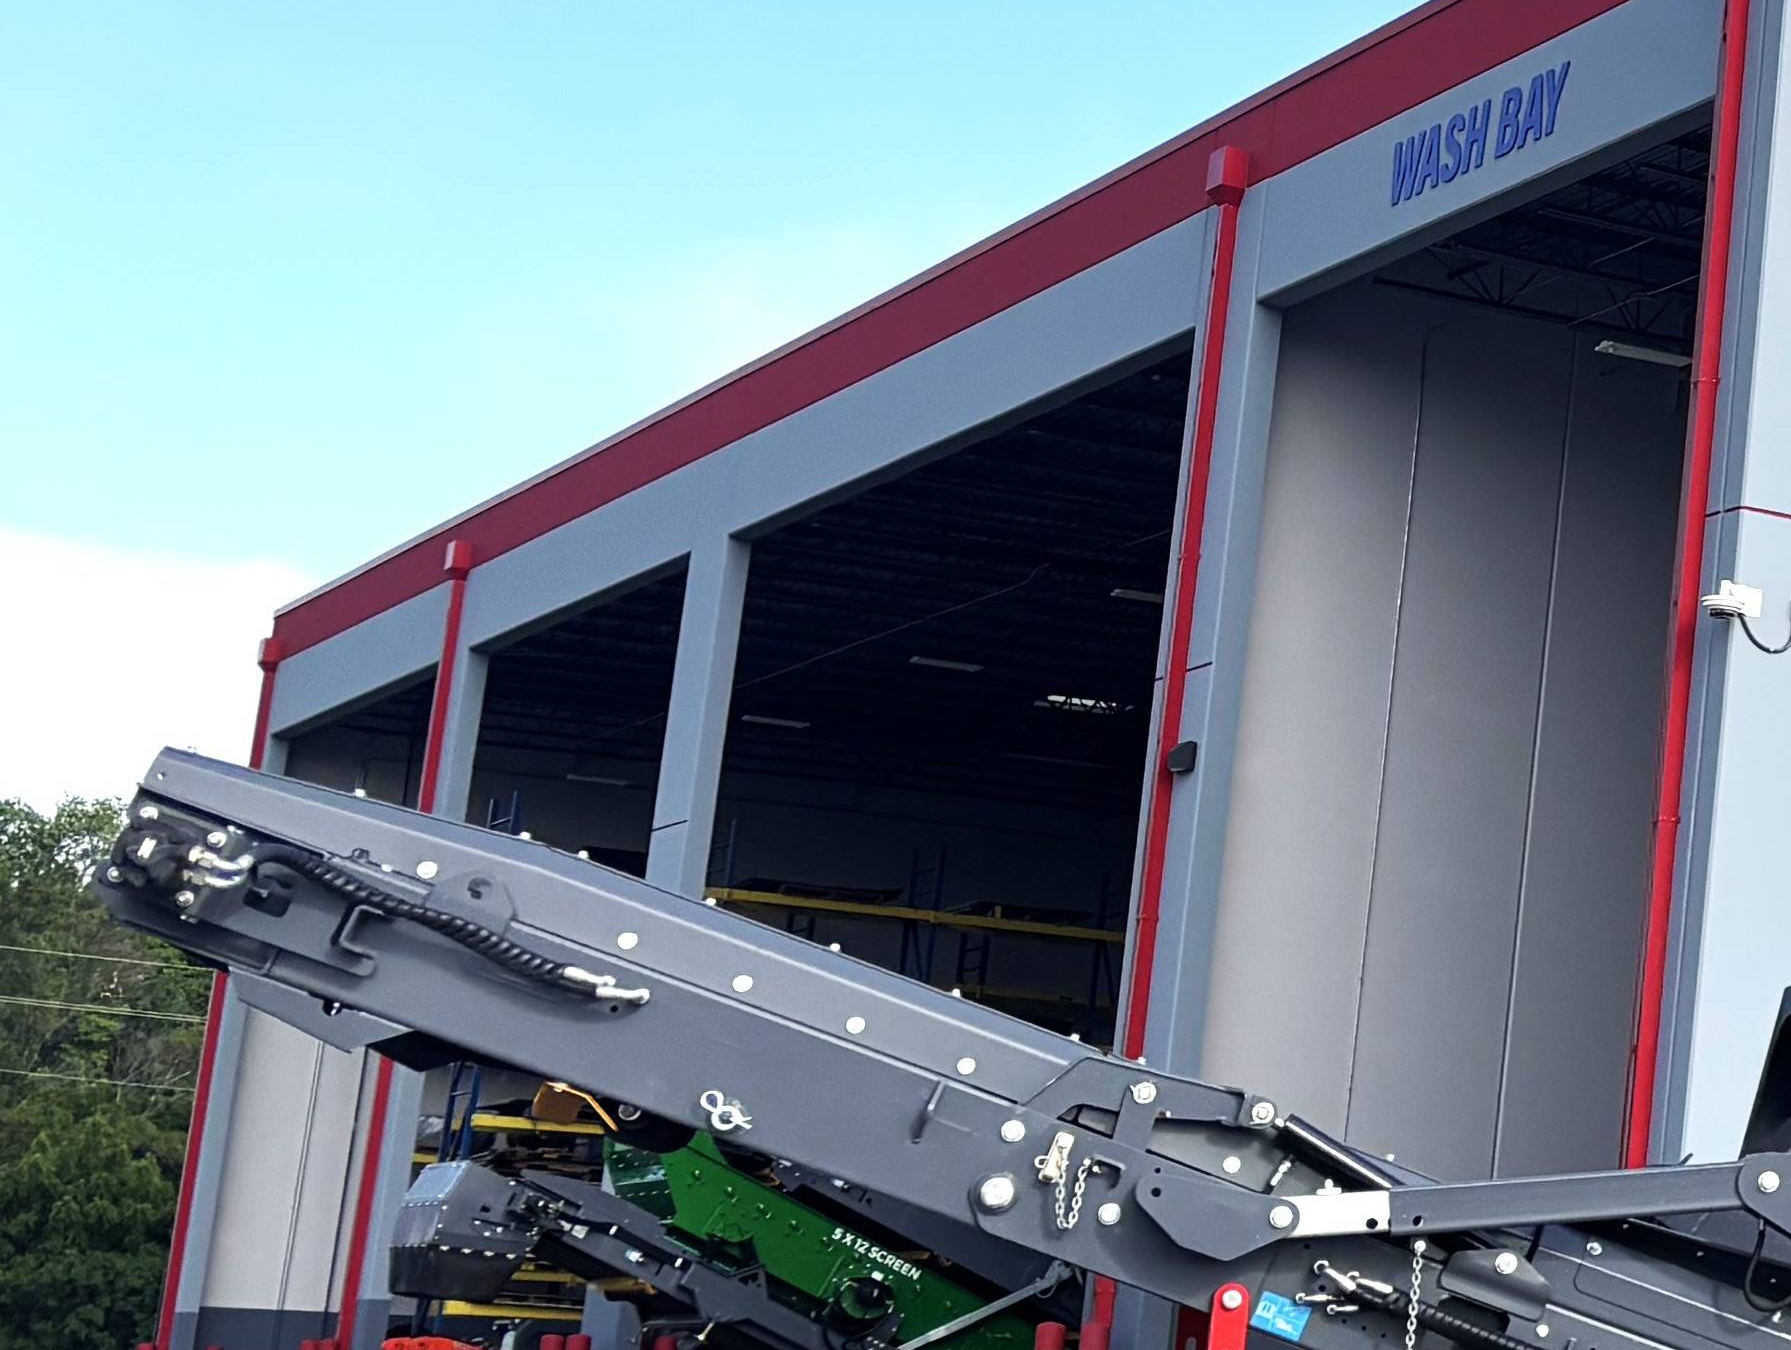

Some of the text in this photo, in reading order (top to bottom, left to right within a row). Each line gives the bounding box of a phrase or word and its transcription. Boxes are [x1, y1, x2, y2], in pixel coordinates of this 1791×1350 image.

[1392, 60, 1571, 207] WASH BAY
[842, 1233, 855, 1246] X
[854, 1238, 870, 1254] 12
[867, 1247, 922, 1280] SCREEN
